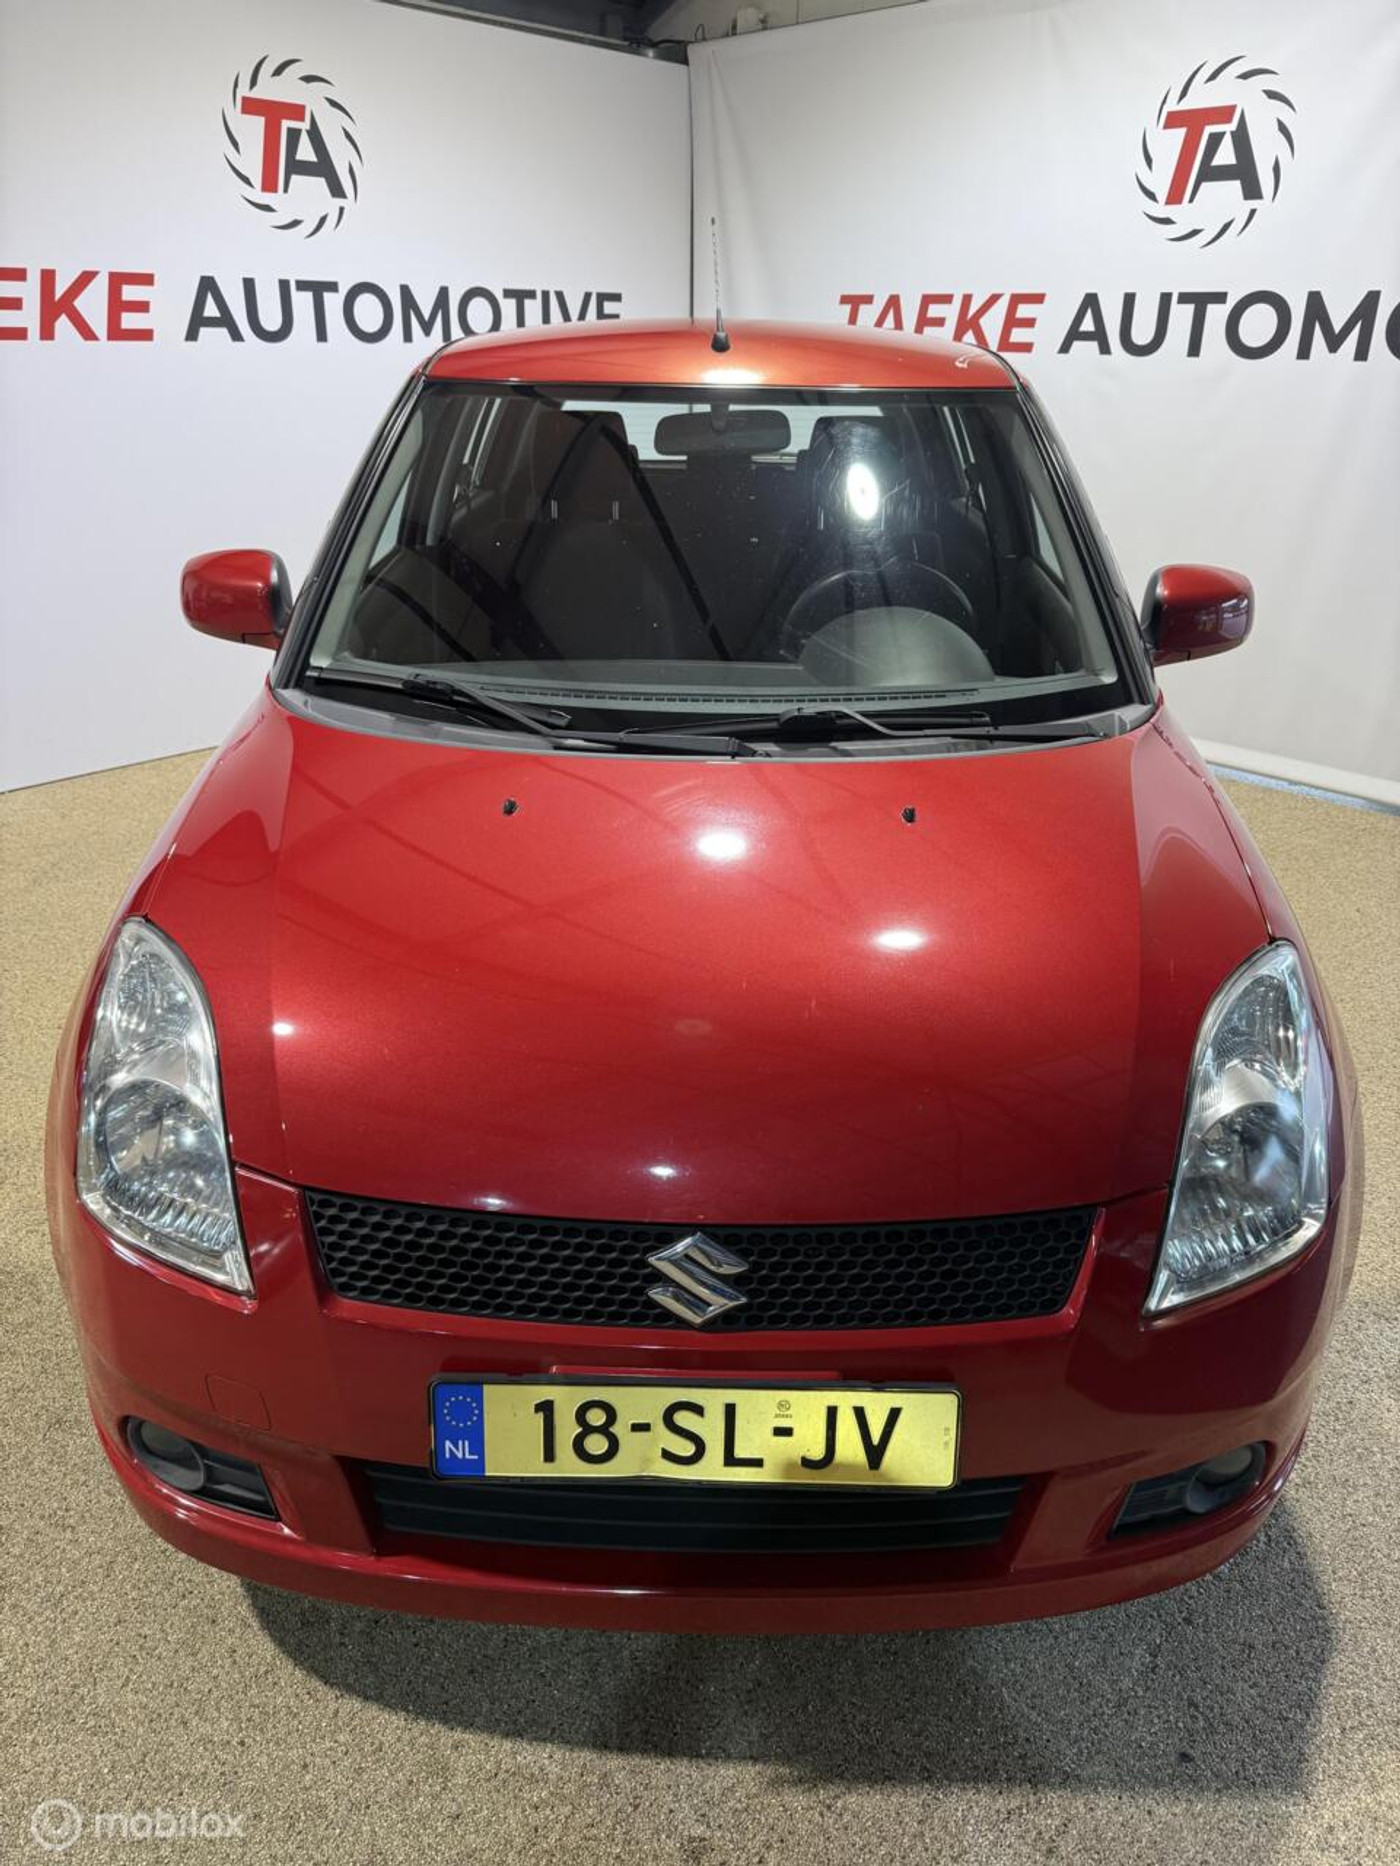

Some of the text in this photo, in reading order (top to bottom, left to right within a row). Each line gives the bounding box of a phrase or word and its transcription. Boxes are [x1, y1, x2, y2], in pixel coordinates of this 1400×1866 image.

[241, 96, 348, 199] TA
[1162, 104, 1264, 206] TA
[185, 275, 622, 344] AUTOMOTIVE
[839, 290, 1400, 362] TAEKE AUTOM
[445, 1440, 479, 1460] NL
[533, 1399, 903, 1472] 18-SL-JV
